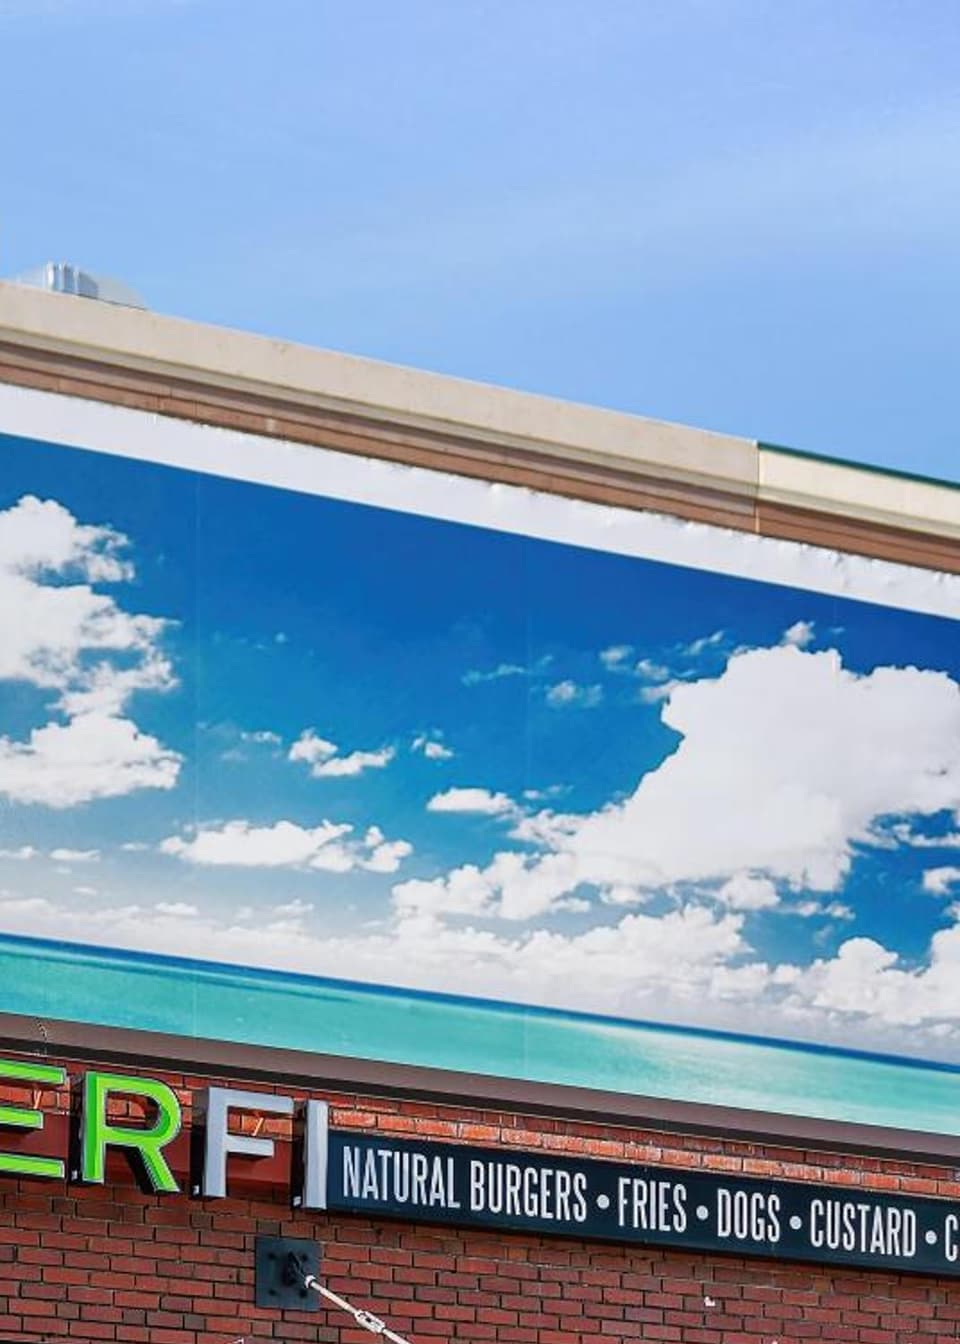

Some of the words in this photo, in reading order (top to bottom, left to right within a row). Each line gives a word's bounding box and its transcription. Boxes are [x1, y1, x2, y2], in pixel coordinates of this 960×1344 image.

[342, 1145, 461, 1208] NATURAL
[470, 1159, 587, 1222] BURGERS
[618, 1177, 687, 1233] FRIES
[717, 1187, 781, 1242] DOGS
[810, 1199, 917, 1257] CUSTARD
